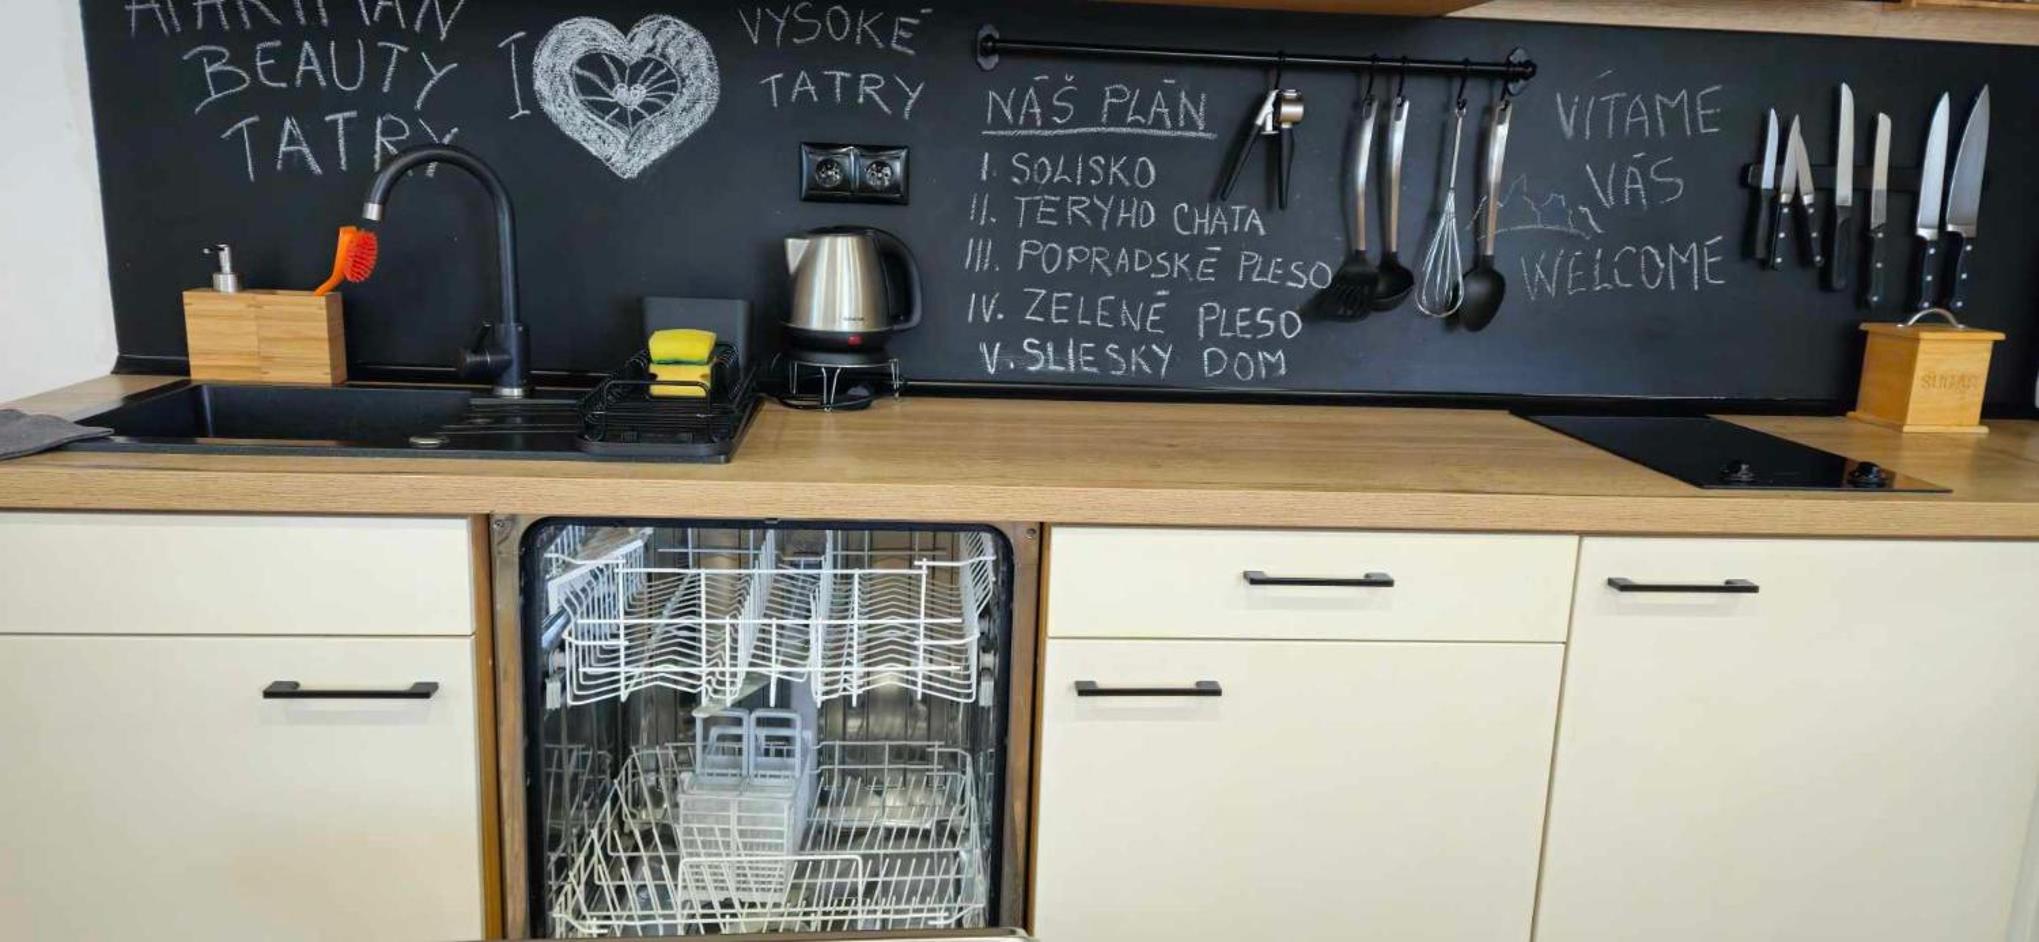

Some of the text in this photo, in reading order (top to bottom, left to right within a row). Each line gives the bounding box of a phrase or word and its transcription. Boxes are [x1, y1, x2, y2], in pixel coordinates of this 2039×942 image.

[739, 2, 933, 55] VYSOKÉ
[182, 38, 459, 114] BEAUTY
[759, 70, 925, 120] TATRY
[987, 73, 1207, 130] NÁŠ PLÁN
[1556, 70, 1723, 140] VÍTAME
[1011, 152, 1156, 188] SOLISKO
[1586, 152, 1684, 210] VÁS
[1173, 203, 1267, 236] CHATA
[1017, 240, 1222, 282] POPRADSKÉ
[1238, 250, 1333, 289] PLESO
[1521, 236, 1725, 301] WELCOME
[1022, 288, 1171, 334] ZELENÉ
[1198, 302, 1303, 340] PLESO
[1203, 347, 1287, 381] DOM
